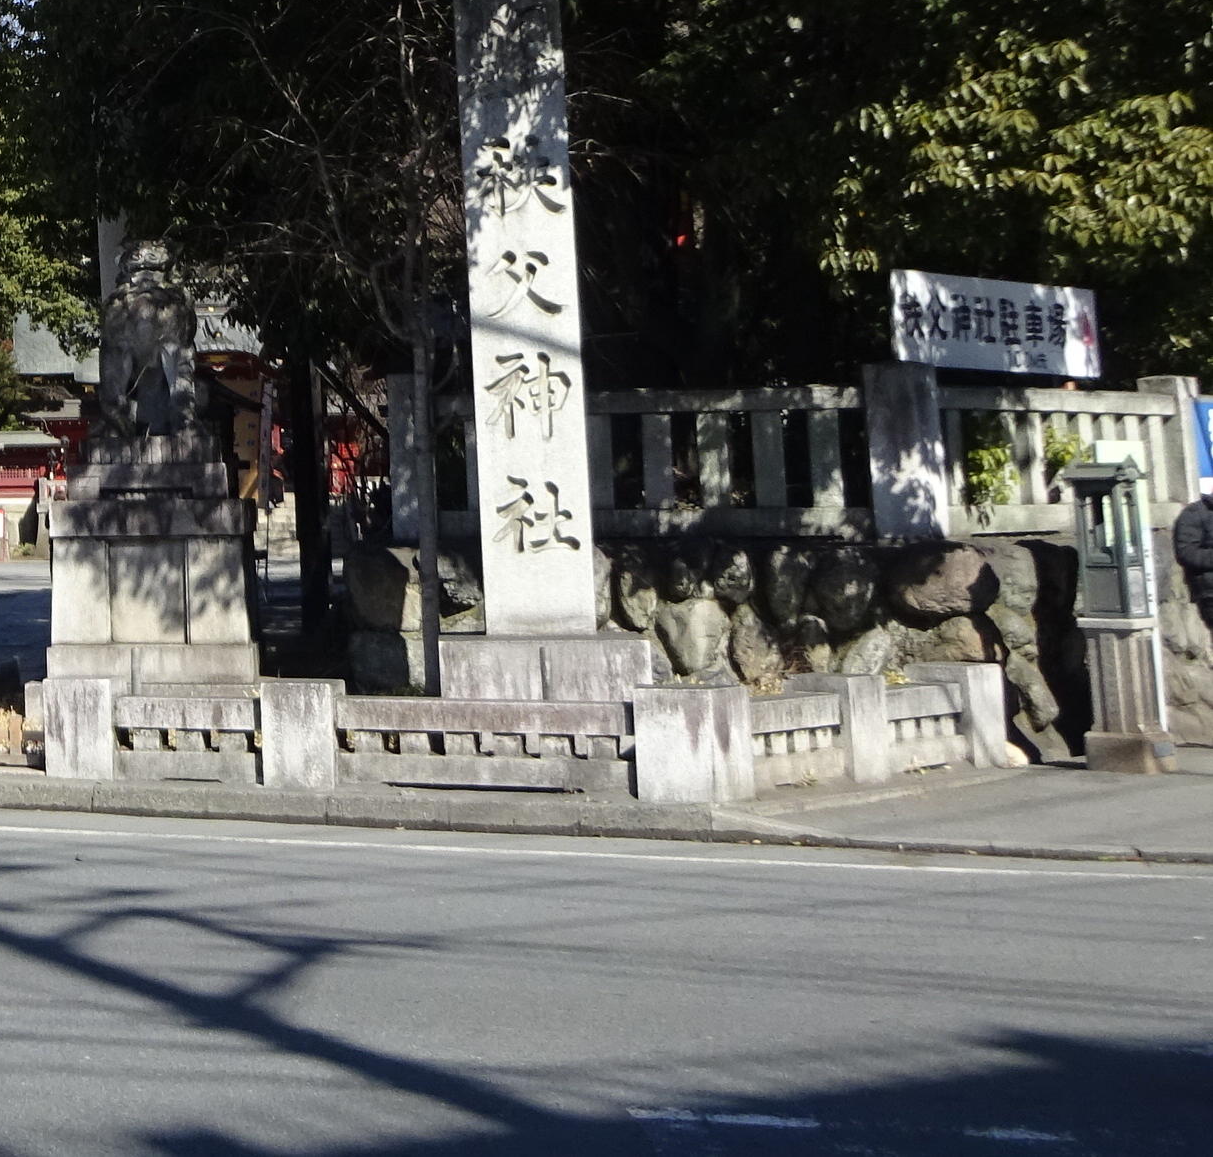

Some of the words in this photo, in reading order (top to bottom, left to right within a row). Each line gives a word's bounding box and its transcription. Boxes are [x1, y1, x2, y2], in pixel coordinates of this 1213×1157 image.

[476, 135, 582, 555] 秩父神社
[899, 292, 1068, 347] 秩父神社駐車場
